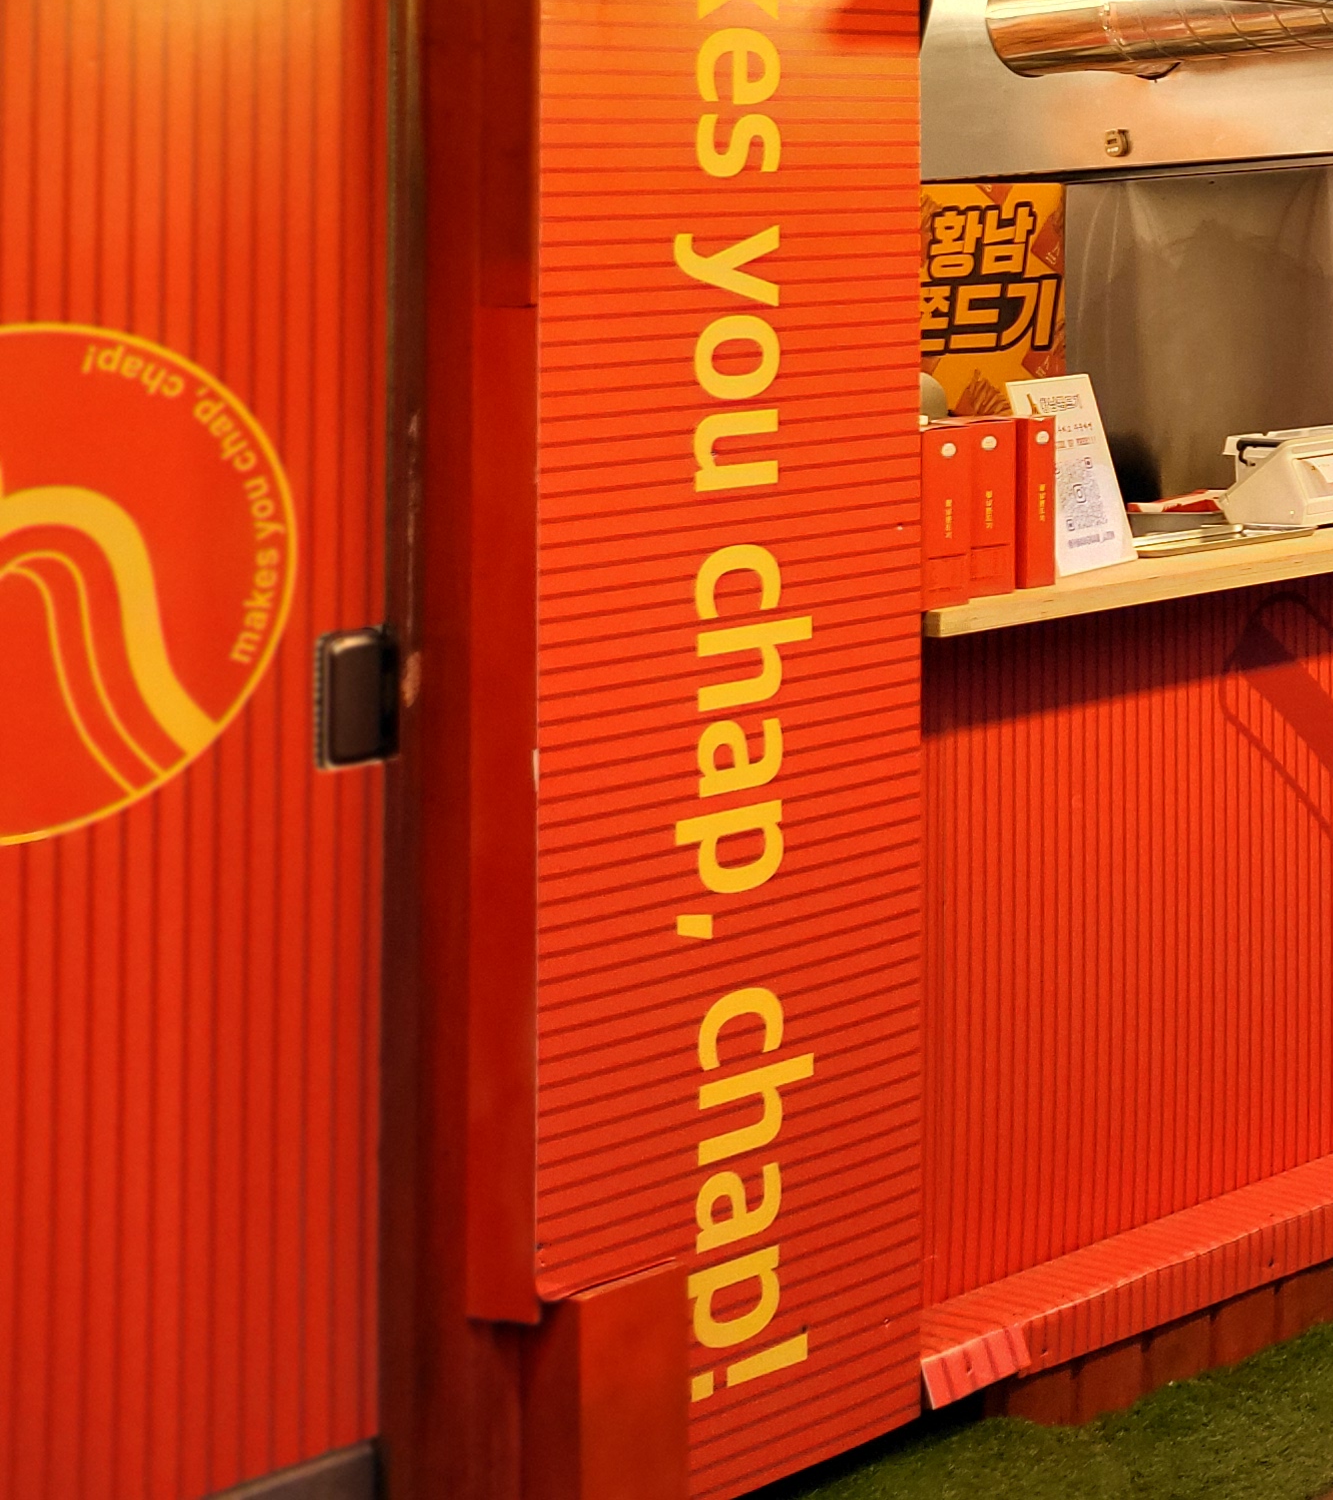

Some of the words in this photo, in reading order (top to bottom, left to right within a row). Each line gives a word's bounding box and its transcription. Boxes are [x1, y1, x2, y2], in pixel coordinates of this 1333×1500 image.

[929, 205, 1035, 278] 황남
[82, 344, 185, 399] chap!
[673, 224, 781, 494] you
[192, 384, 257, 474] chap,
[245, 475, 285, 539] you
[230, 548, 280, 665] makes
[675, 544, 813, 940] chap,
[687, 986, 815, 1403] chap!
